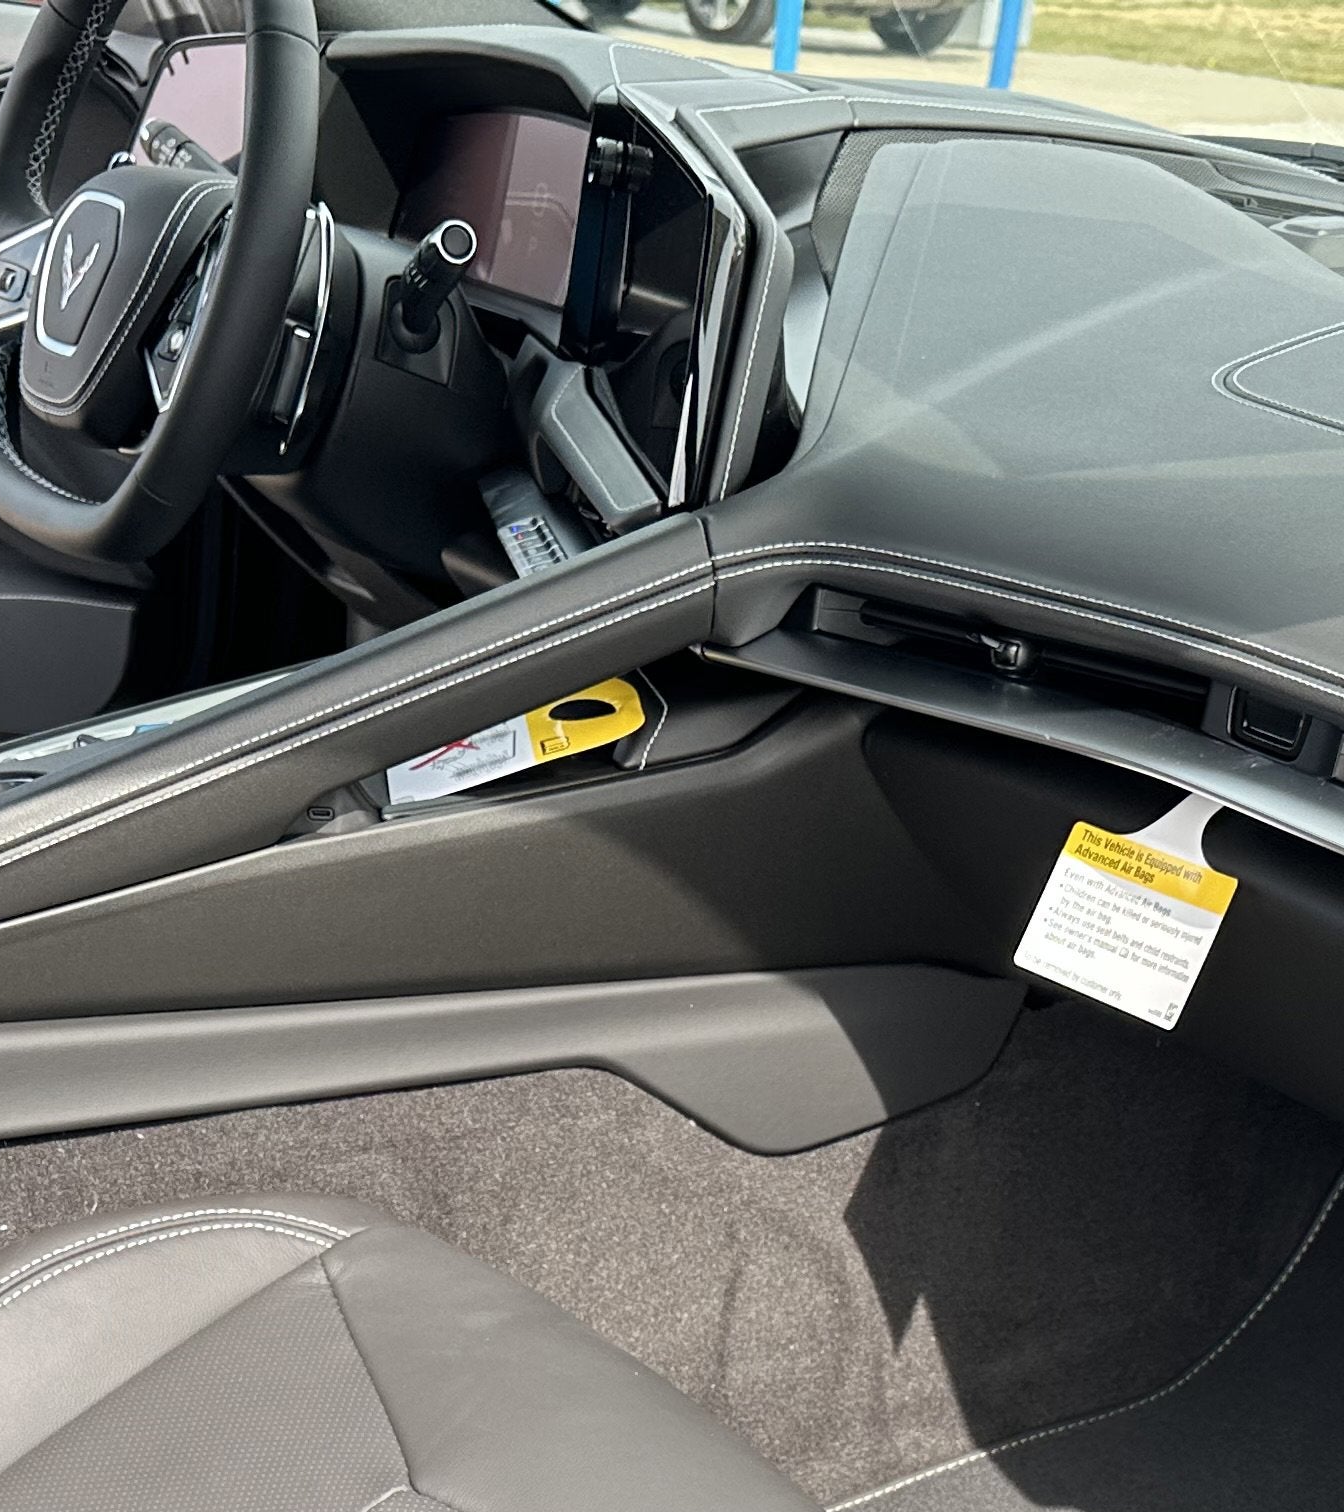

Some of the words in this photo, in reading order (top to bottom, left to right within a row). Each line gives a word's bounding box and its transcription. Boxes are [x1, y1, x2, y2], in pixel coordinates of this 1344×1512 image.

[1074, 843, 1121, 870] Advanced
[1133, 866, 1156, 884] Bags
[1081, 828, 1103, 847] This
[1103, 838, 1135, 859] Vehicle
[1144, 852, 1184, 877] Equipped
[1182, 869, 1203, 884] with
[1064, 867, 1085, 882] Even
[1086, 878, 1104, 890] with
[1104, 885, 1142, 905] Advanced
[1152, 901, 1172, 917] Bags
[1064, 883, 1097, 903] Children
[1052, 906, 1081, 925] Always
